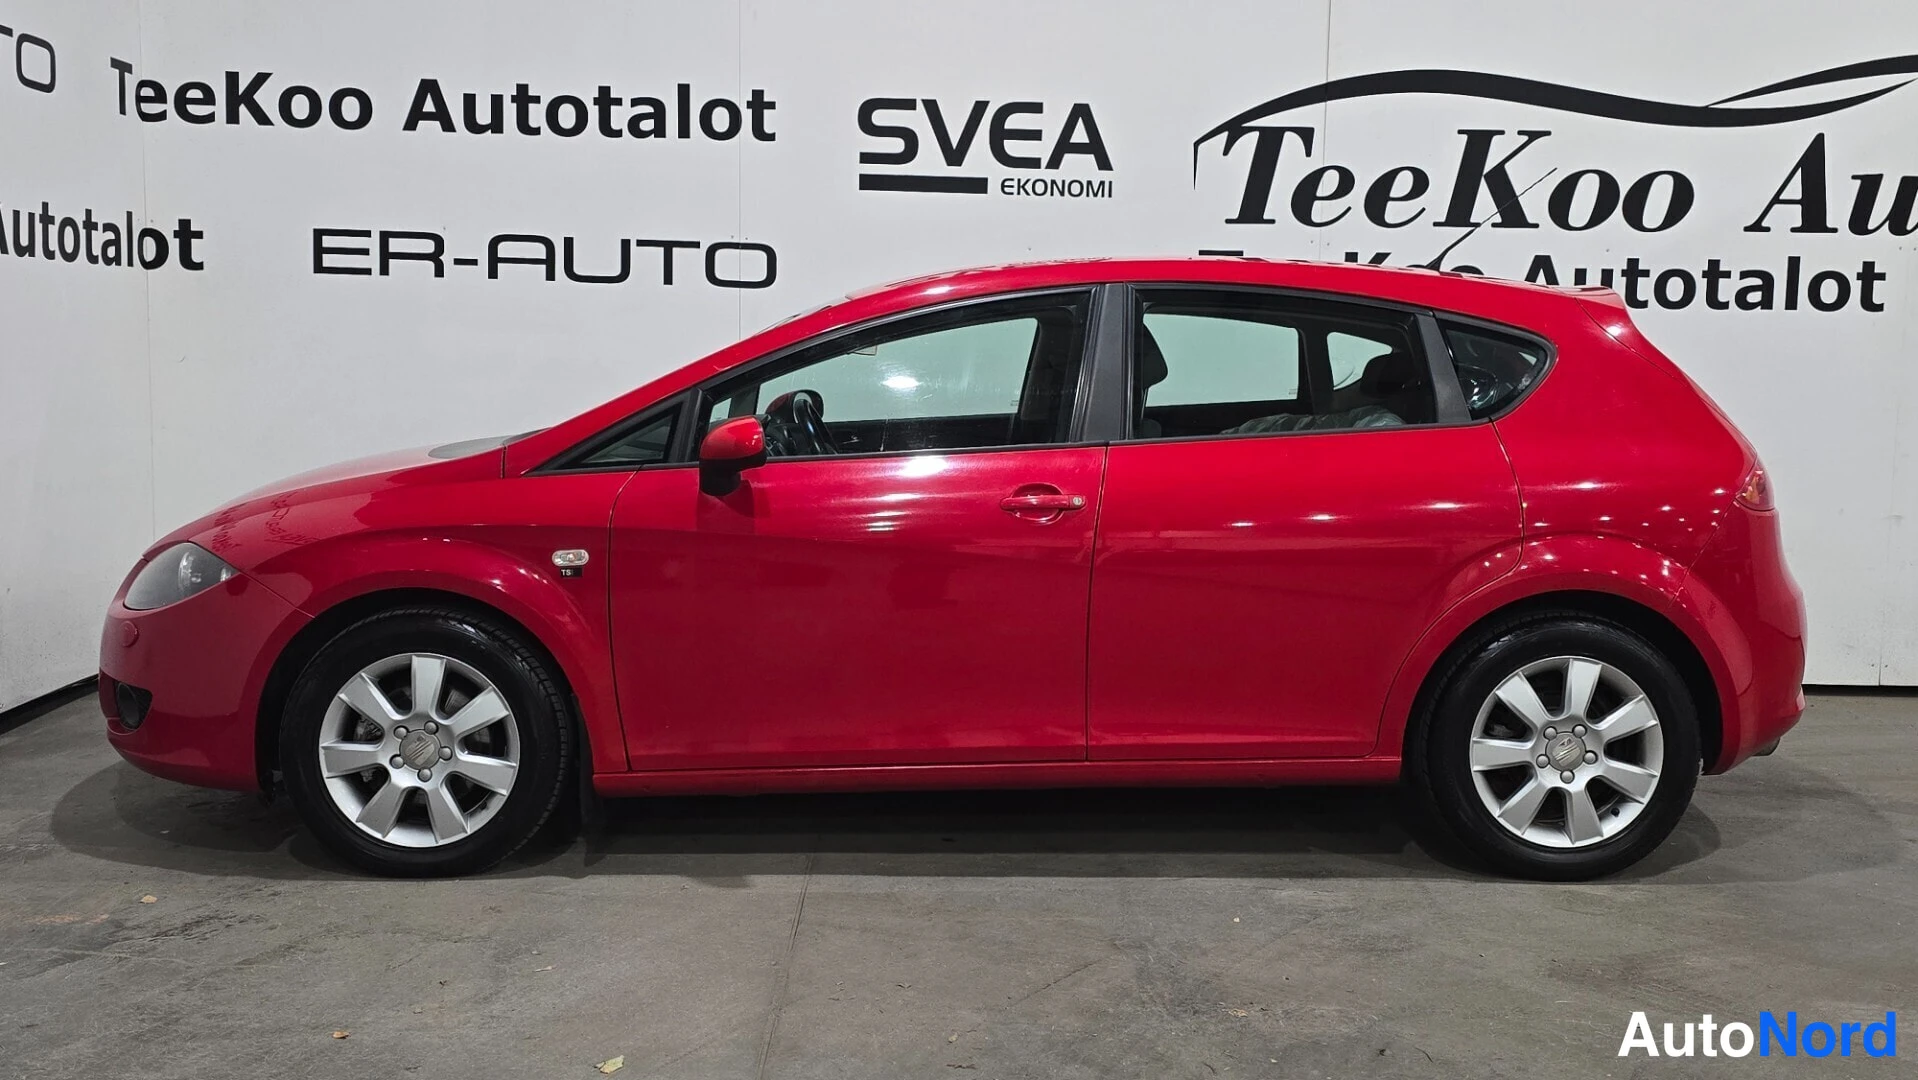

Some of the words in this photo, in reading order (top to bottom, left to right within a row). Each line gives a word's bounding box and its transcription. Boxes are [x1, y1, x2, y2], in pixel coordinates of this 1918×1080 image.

[110, 56, 373, 132] TeeKoo
[402, 78, 777, 142] Autotalot
[857, 97, 1114, 172] SVEA
[1000, 177, 1114, 199] EKONOMI
[1221, 125, 1696, 233] TeeKoo
[312, 228, 777, 289] ER-AUTO
